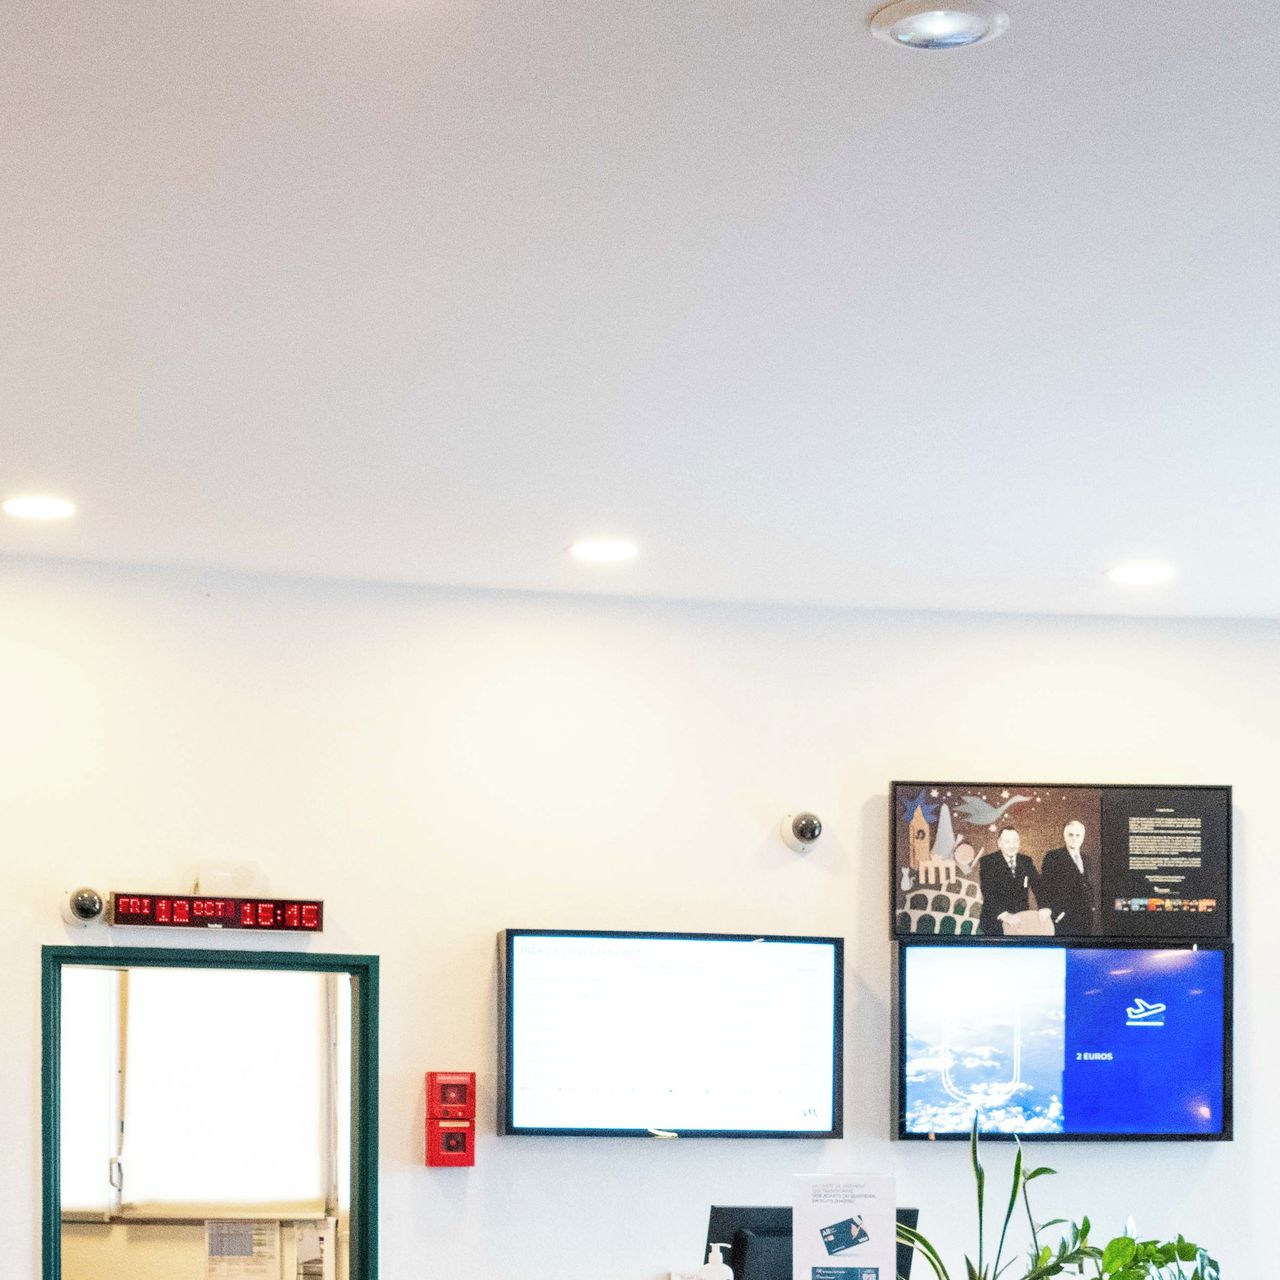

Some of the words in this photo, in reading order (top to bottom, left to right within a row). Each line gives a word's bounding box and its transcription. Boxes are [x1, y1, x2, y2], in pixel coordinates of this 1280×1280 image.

[119, 898, 151, 914] FRI
[158, 900, 189, 922] 12
[193, 901, 225, 916] OCT
[1076, 1051, 1083, 1061] 2
[1083, 1051, 1114, 1061] EUROS
